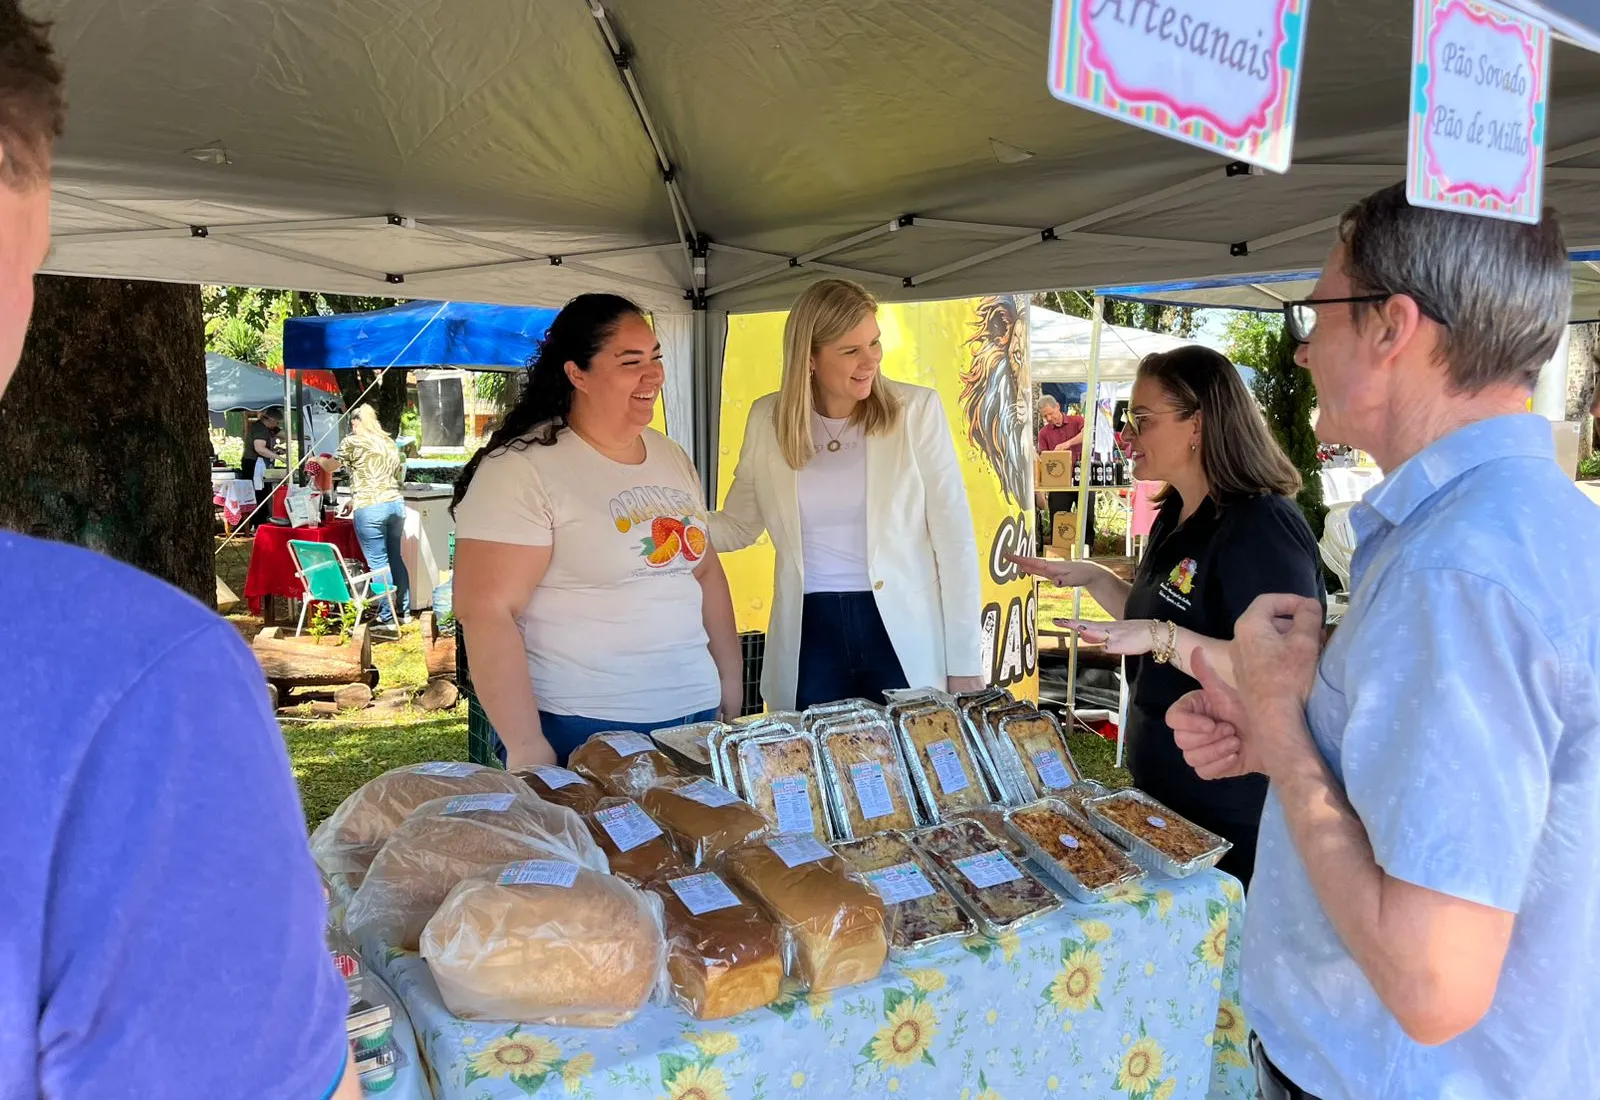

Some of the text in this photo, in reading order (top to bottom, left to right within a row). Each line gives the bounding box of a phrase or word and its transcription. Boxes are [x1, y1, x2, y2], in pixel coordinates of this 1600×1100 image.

[1442, 42, 1526, 96] Pão Sovado
[1432, 104, 1528, 157] Pão de Milho
